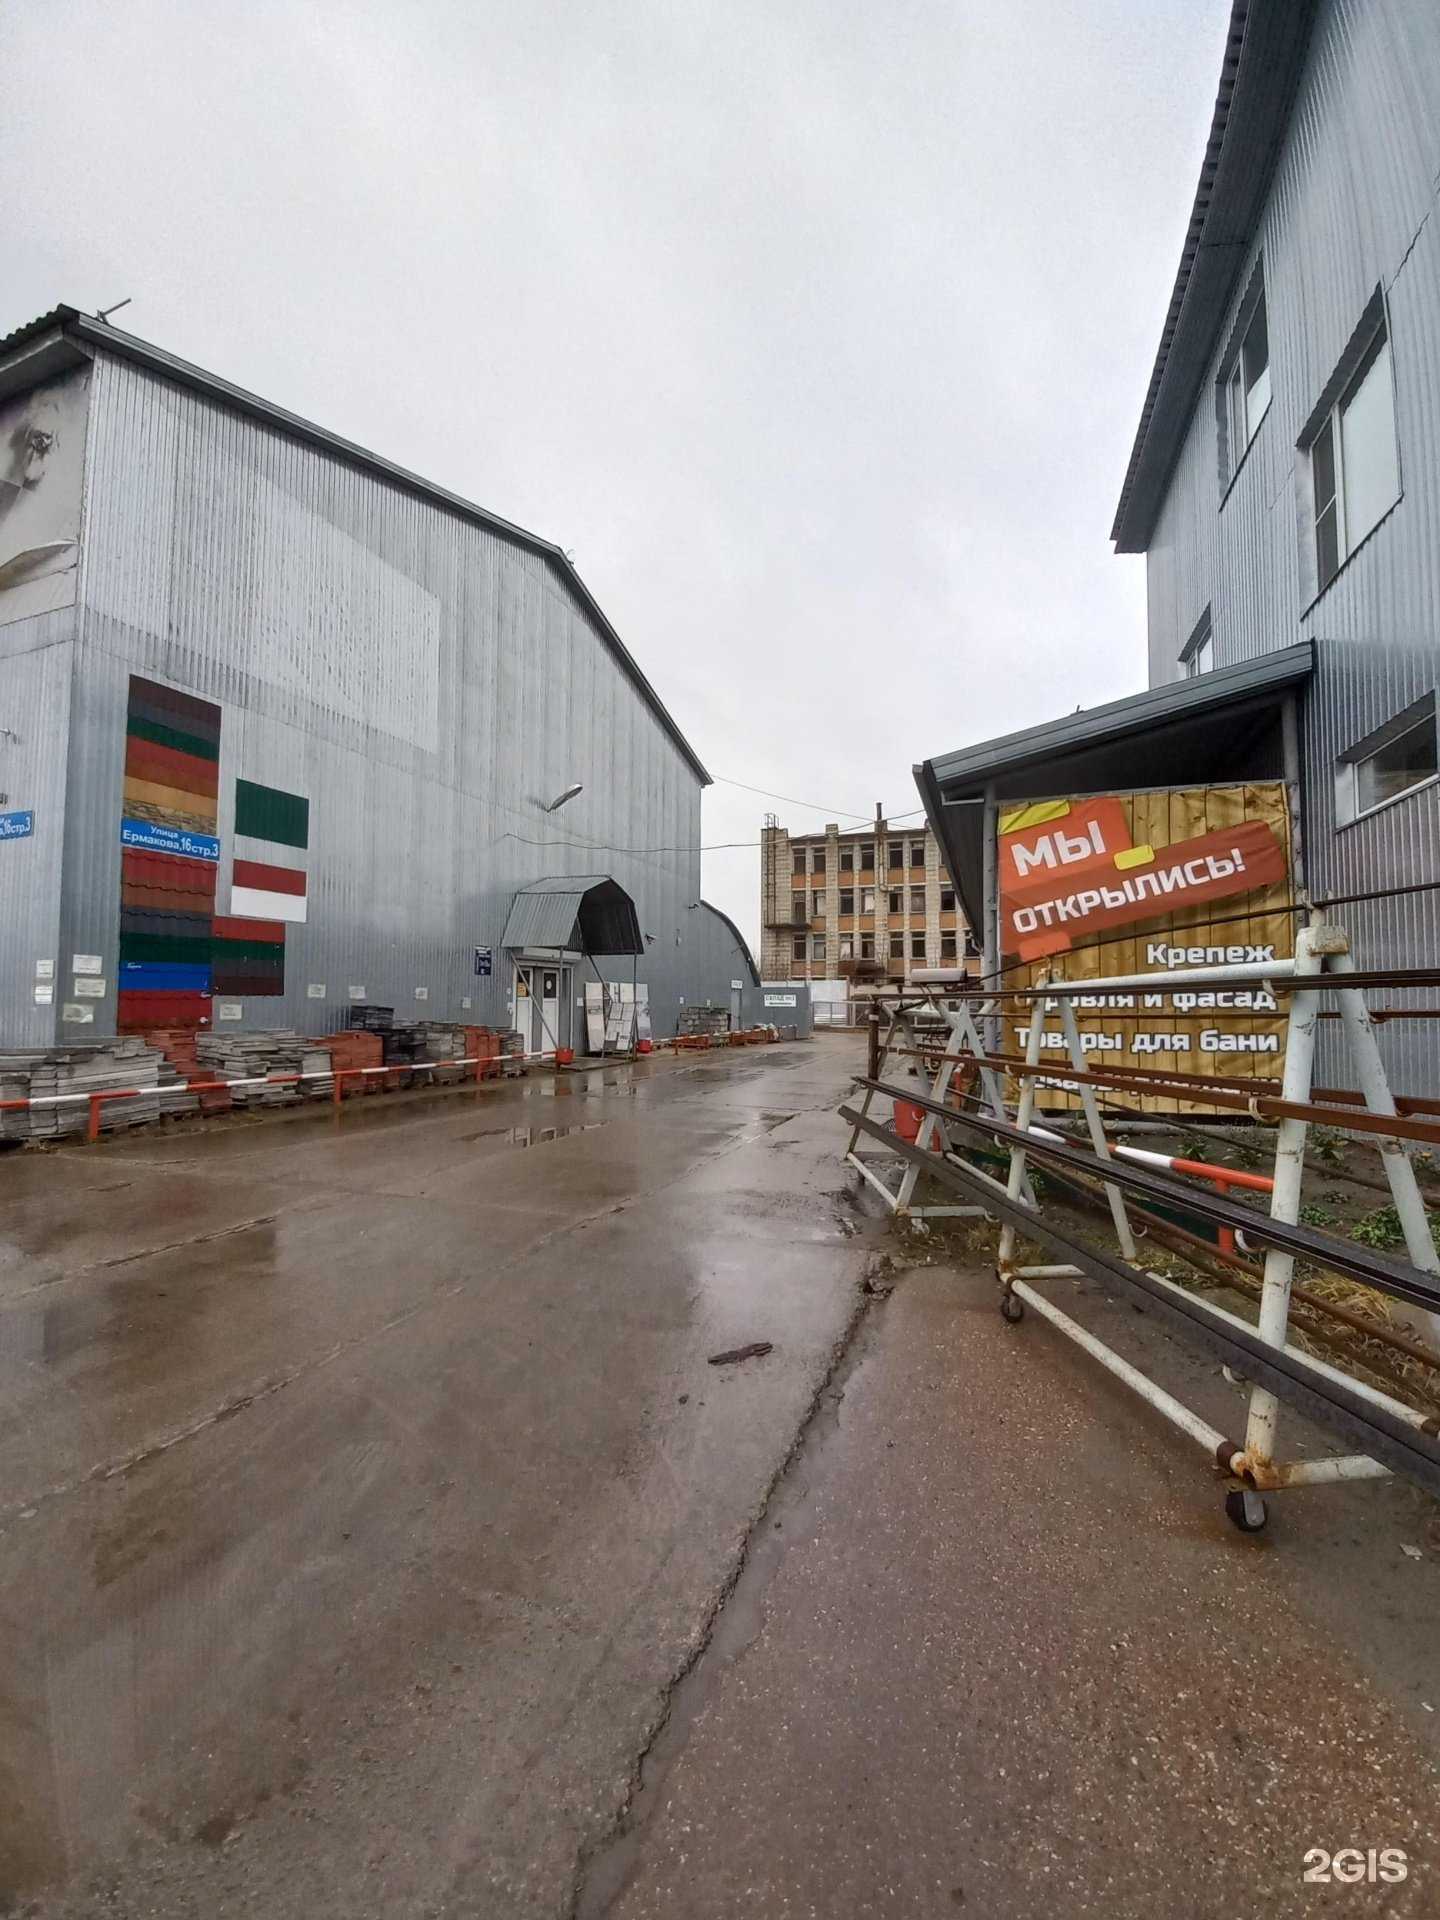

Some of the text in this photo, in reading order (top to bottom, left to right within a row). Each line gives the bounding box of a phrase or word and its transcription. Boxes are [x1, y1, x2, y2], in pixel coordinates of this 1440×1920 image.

[150, 825, 179, 840] Улица
[1011, 820, 1107, 877] МЫ
[1012, 848, 1246, 933] ОТКРЫЛИСЬ!
[1147, 943, 1275, 968] Крепеж
[1144, 993, 1163, 1008] и
[1172, 990, 1277, 1013] фасад
[1131, 1033, 1190, 1053] для
[1200, 1029, 1279, 1052] бани
